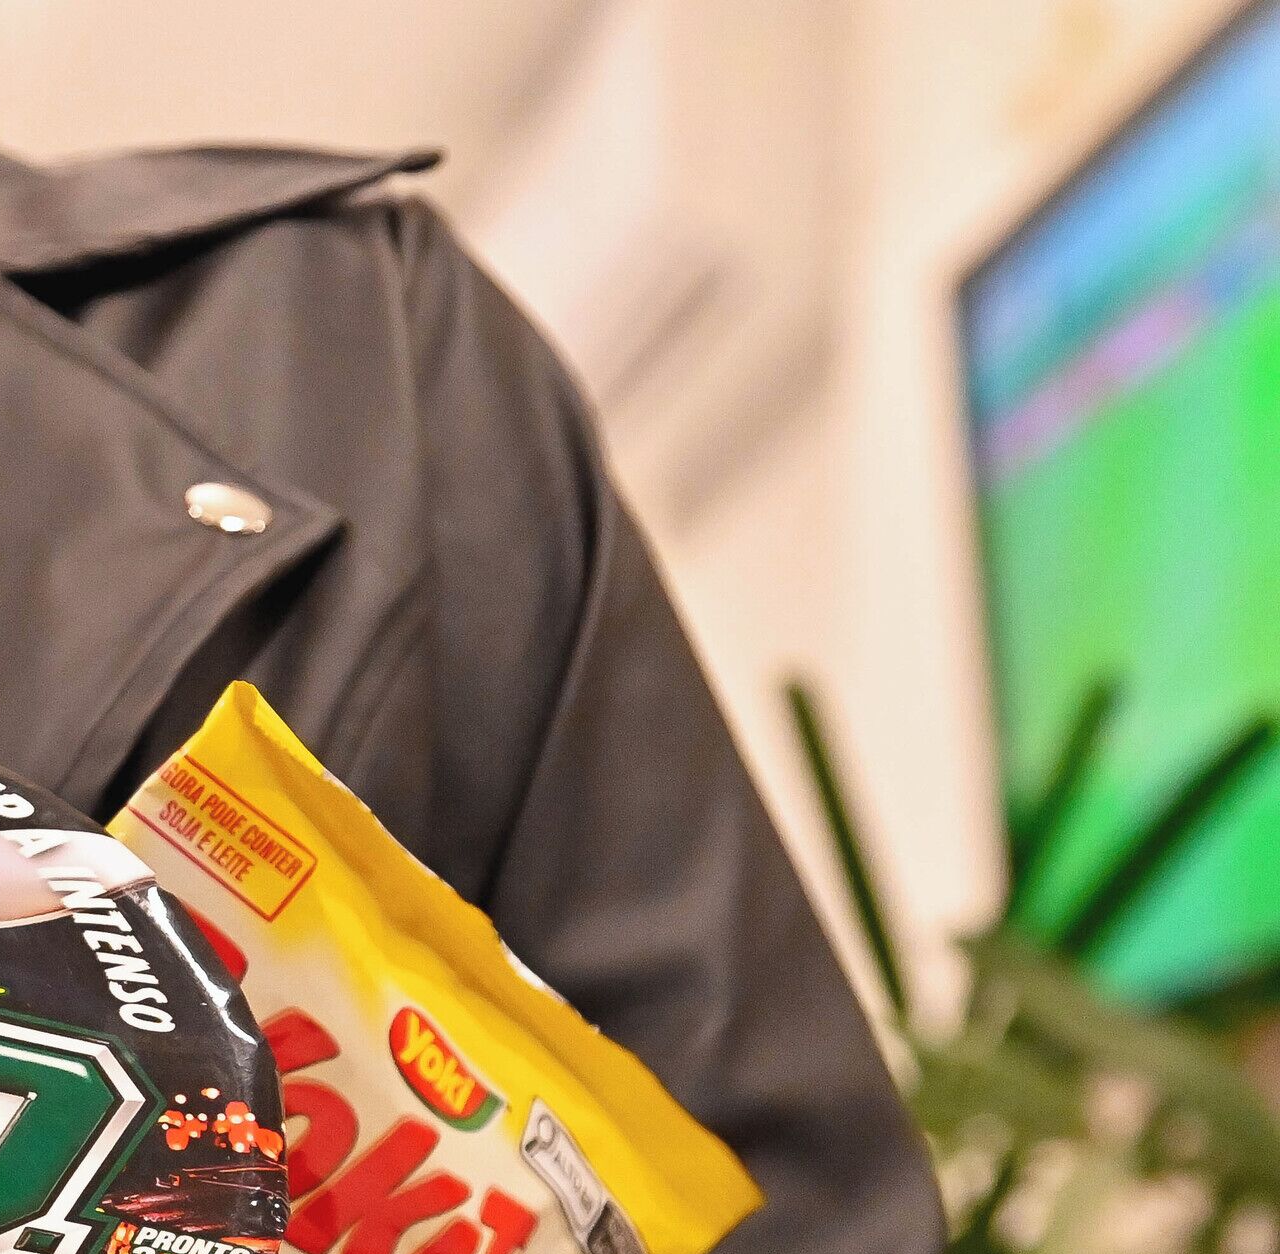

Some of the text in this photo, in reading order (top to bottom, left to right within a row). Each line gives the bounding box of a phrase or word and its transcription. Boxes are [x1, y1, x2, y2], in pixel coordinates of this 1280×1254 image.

[159, 800, 255, 882] SOJA E LEITE
[199, 793, 247, 836] PODE
[240, 824, 304, 879] CONTER
[37, 865, 176, 1033] INTENSO
